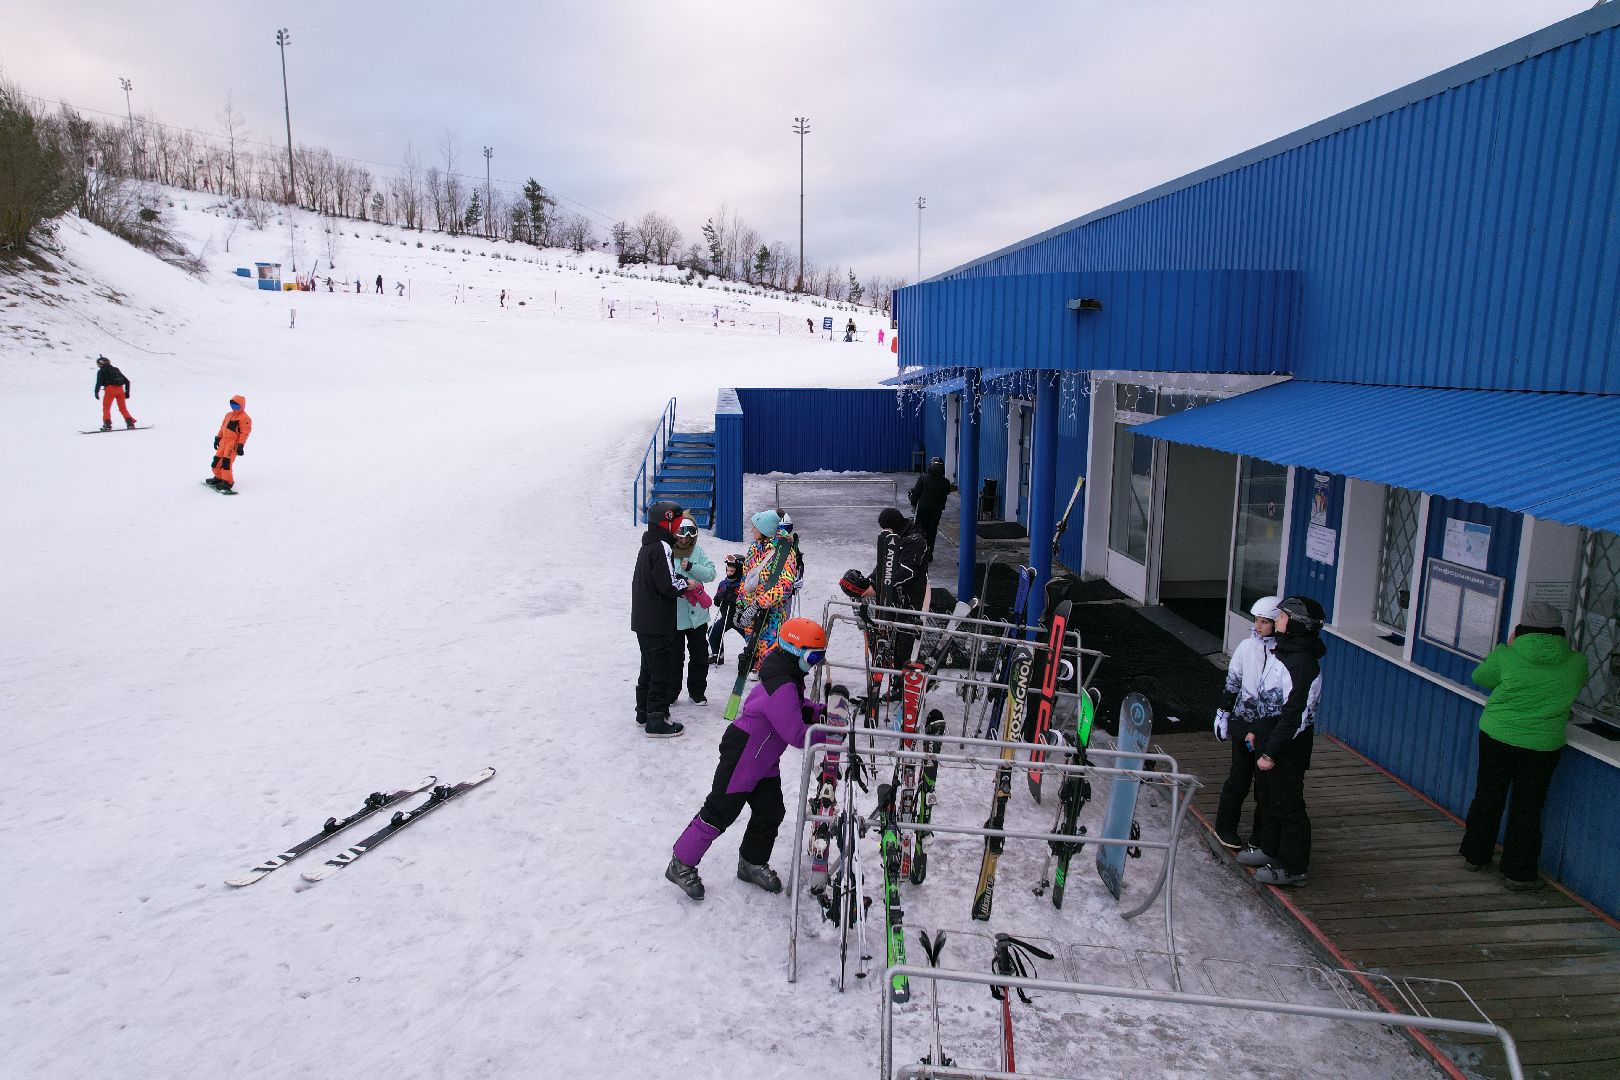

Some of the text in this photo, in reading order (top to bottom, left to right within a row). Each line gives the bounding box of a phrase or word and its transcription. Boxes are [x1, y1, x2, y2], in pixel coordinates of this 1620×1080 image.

[885, 548, 895, 586] ATOMIC
[1432, 565, 1485, 585] Информация
[1009, 659, 1033, 742] ROSSIGNOL
